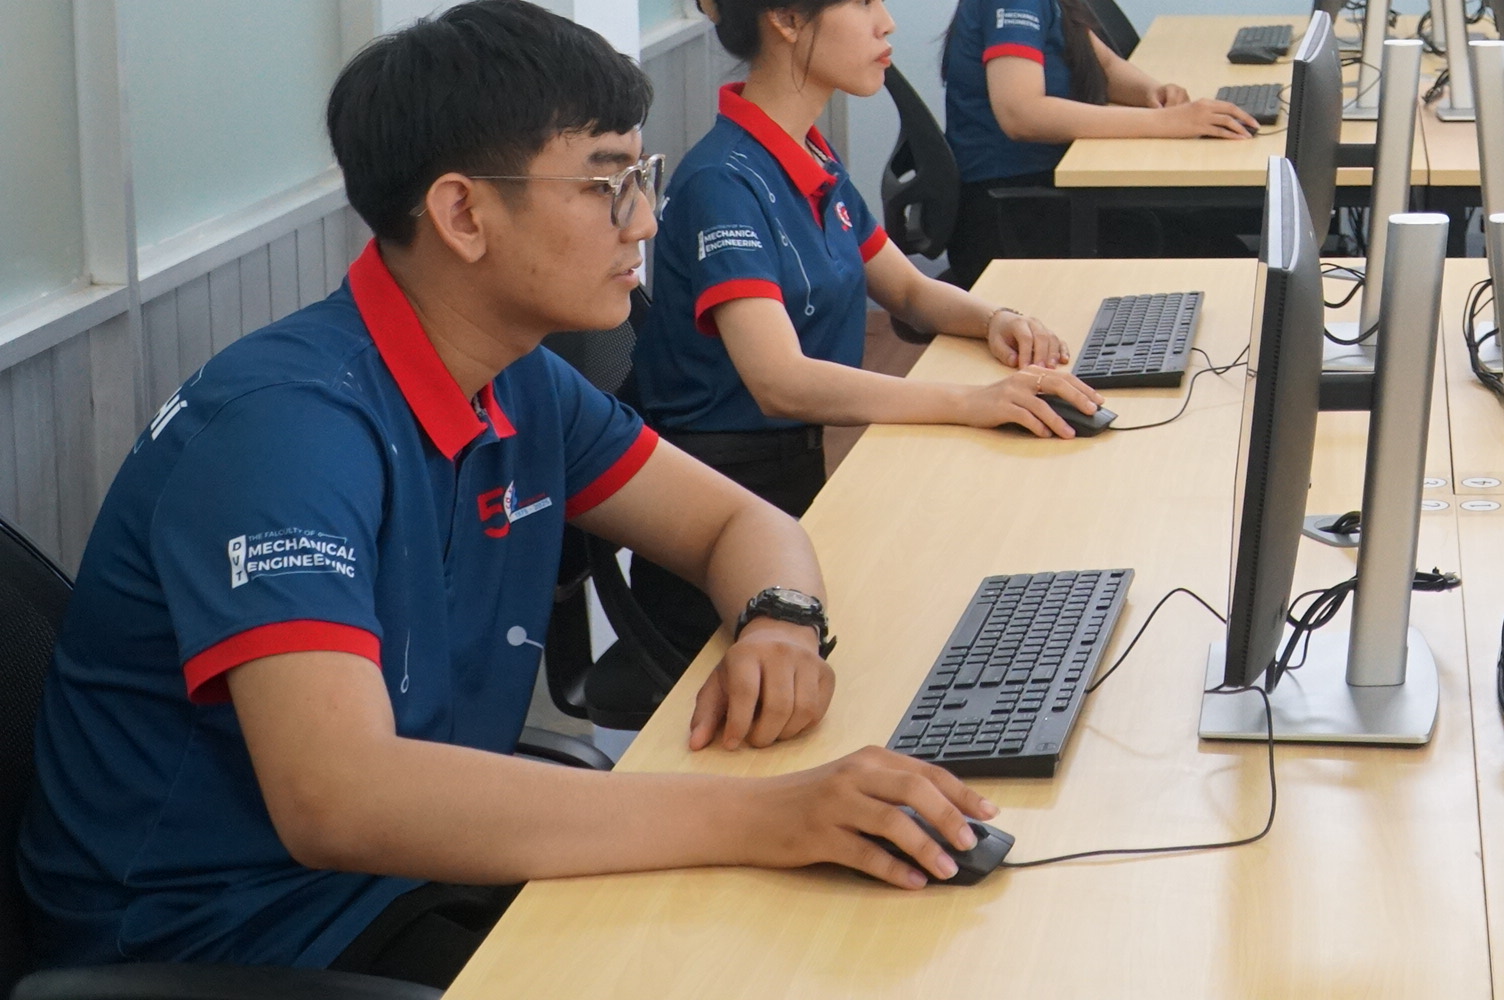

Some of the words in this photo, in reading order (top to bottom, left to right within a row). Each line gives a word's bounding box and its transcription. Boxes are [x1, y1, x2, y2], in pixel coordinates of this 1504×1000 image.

[248, 533, 262, 542] THE
[303, 529, 316, 537] OF
[248, 537, 357, 562] MECHANICAL
